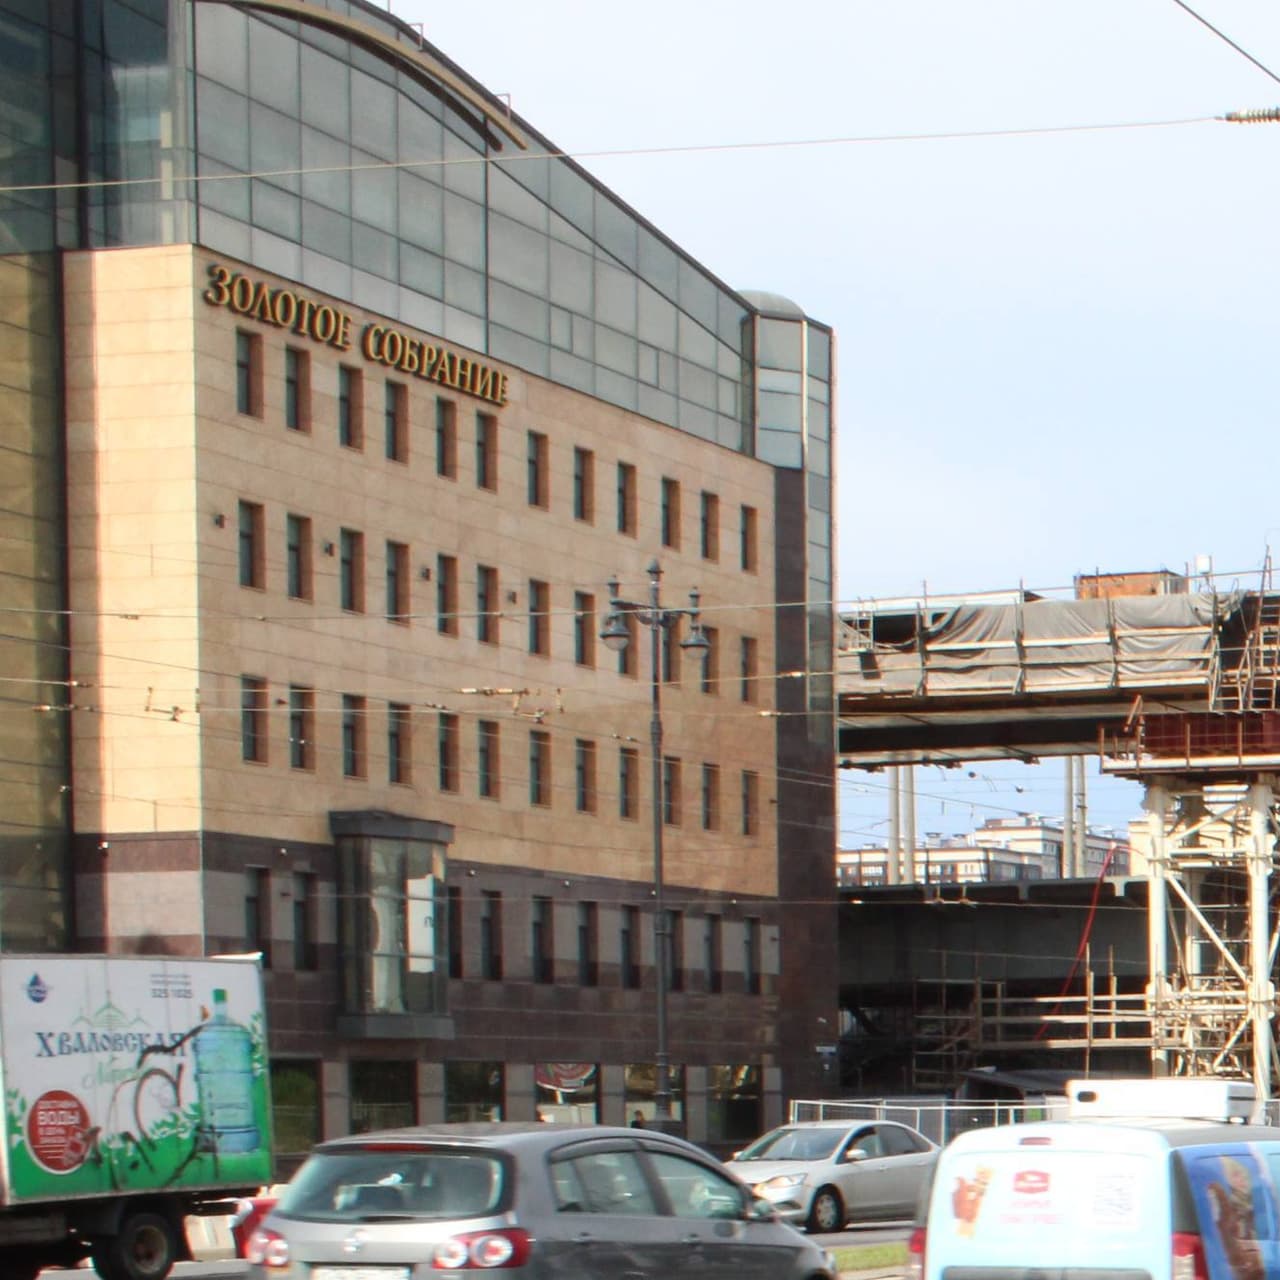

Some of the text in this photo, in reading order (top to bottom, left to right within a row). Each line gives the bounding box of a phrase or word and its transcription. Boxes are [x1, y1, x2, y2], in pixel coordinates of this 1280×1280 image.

[203, 263, 508, 407] ЗОЛОТОЕ СОБРАНИЕ
[37, 1111, 80, 1125] ВОДЫ
